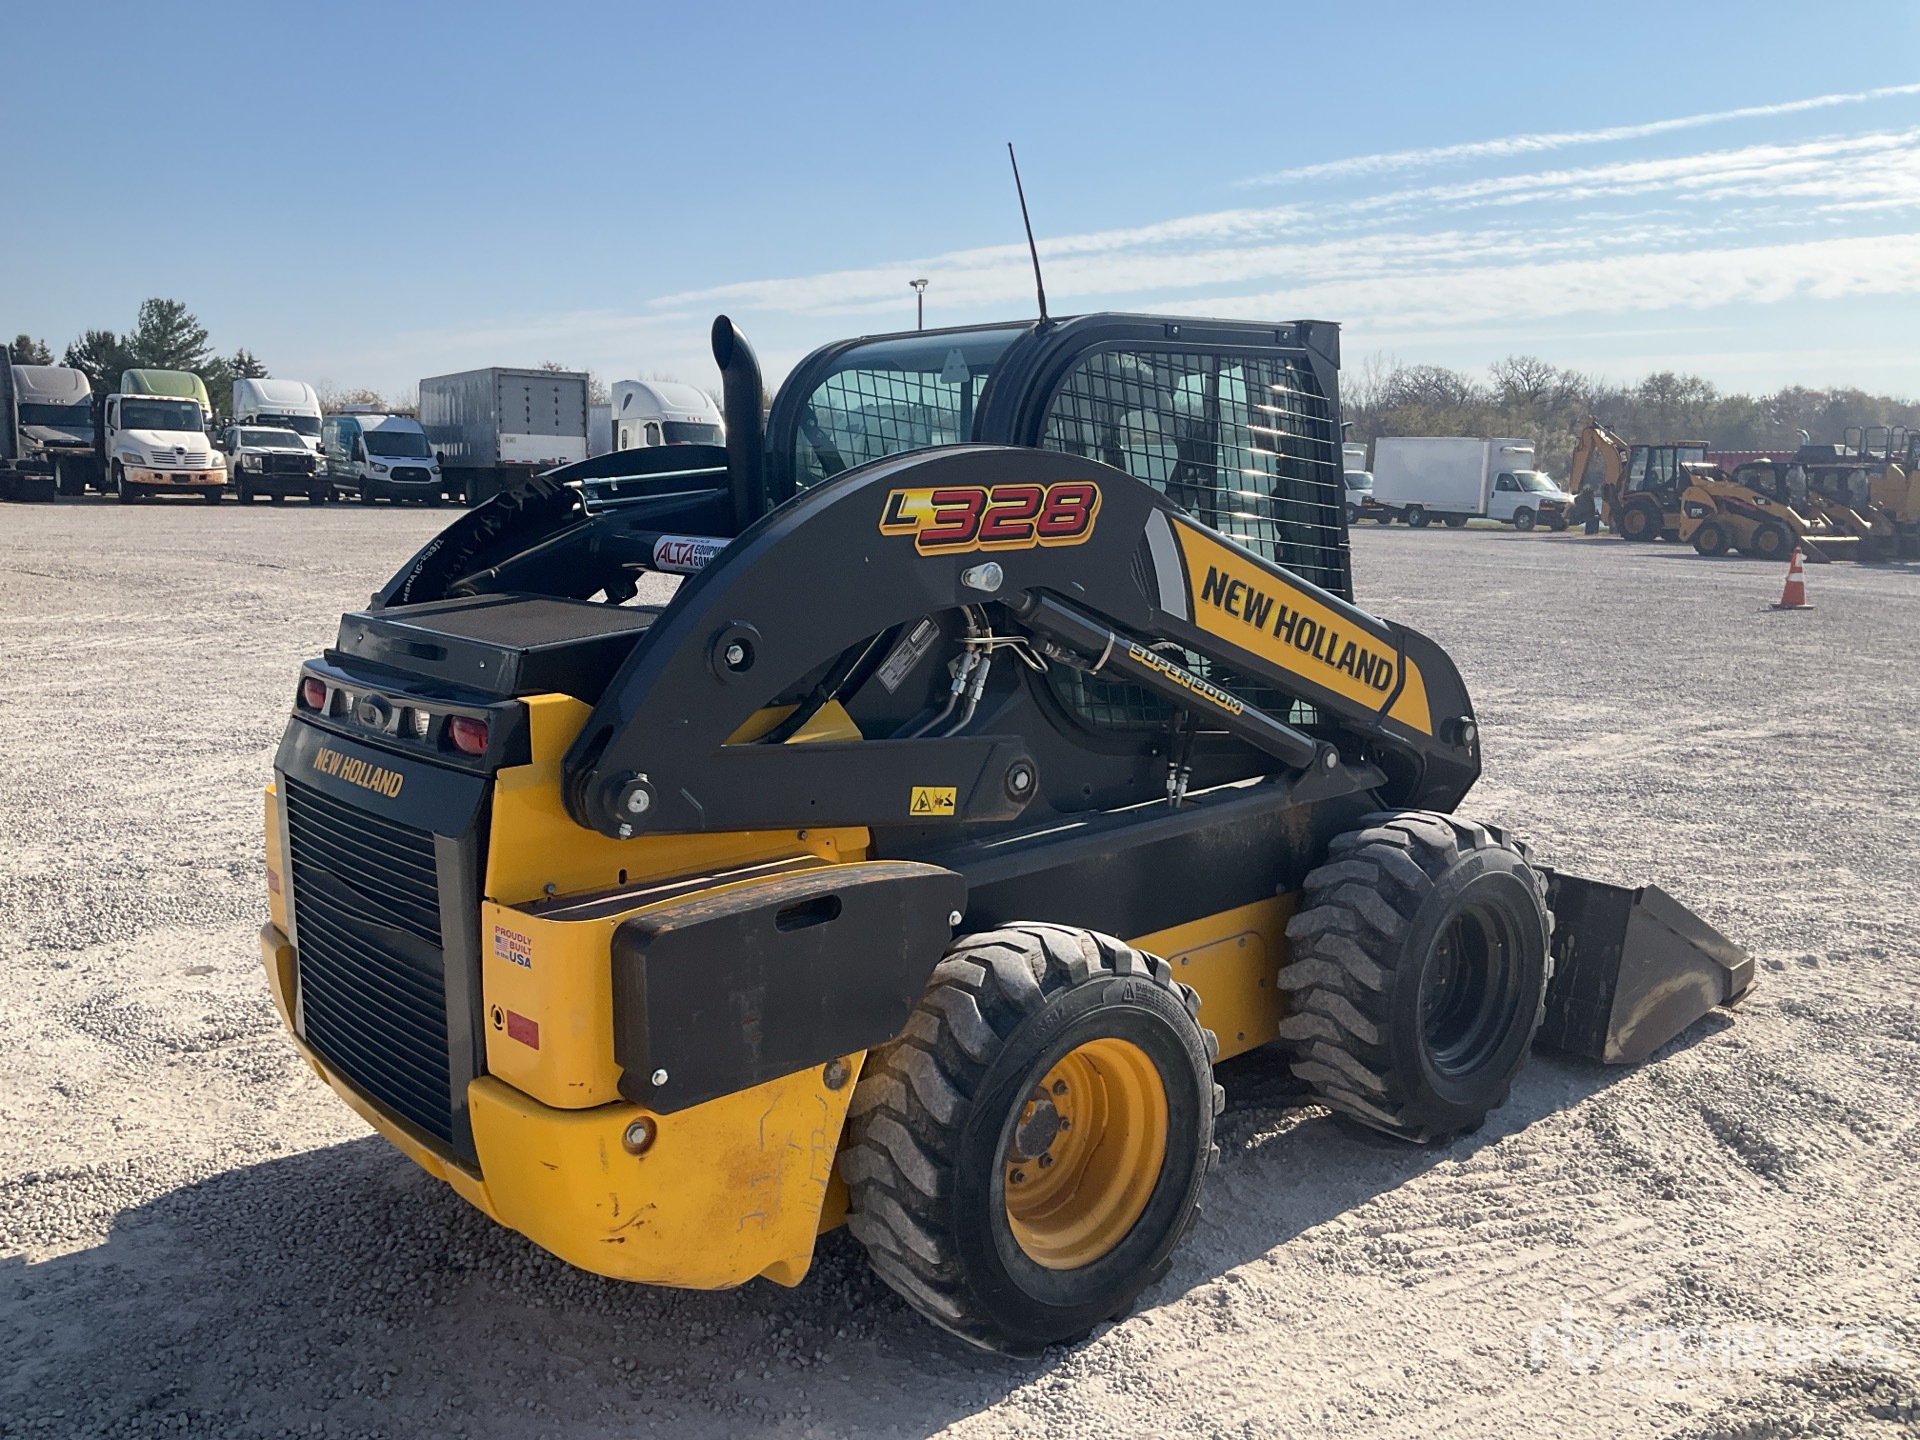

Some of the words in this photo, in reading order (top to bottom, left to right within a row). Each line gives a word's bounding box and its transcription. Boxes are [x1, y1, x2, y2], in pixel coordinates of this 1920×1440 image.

[655, 541, 695, 566] ALTA
[1200, 565, 1274, 631] NEW
[1272, 603, 1394, 693] HOLLAND
[313, 747, 344, 776] NEW
[338, 756, 404, 798] HOLLAND
[495, 925, 532, 946] PROUDLY
[509, 940, 532, 956] BUILT
[509, 950, 532, 970] USA
